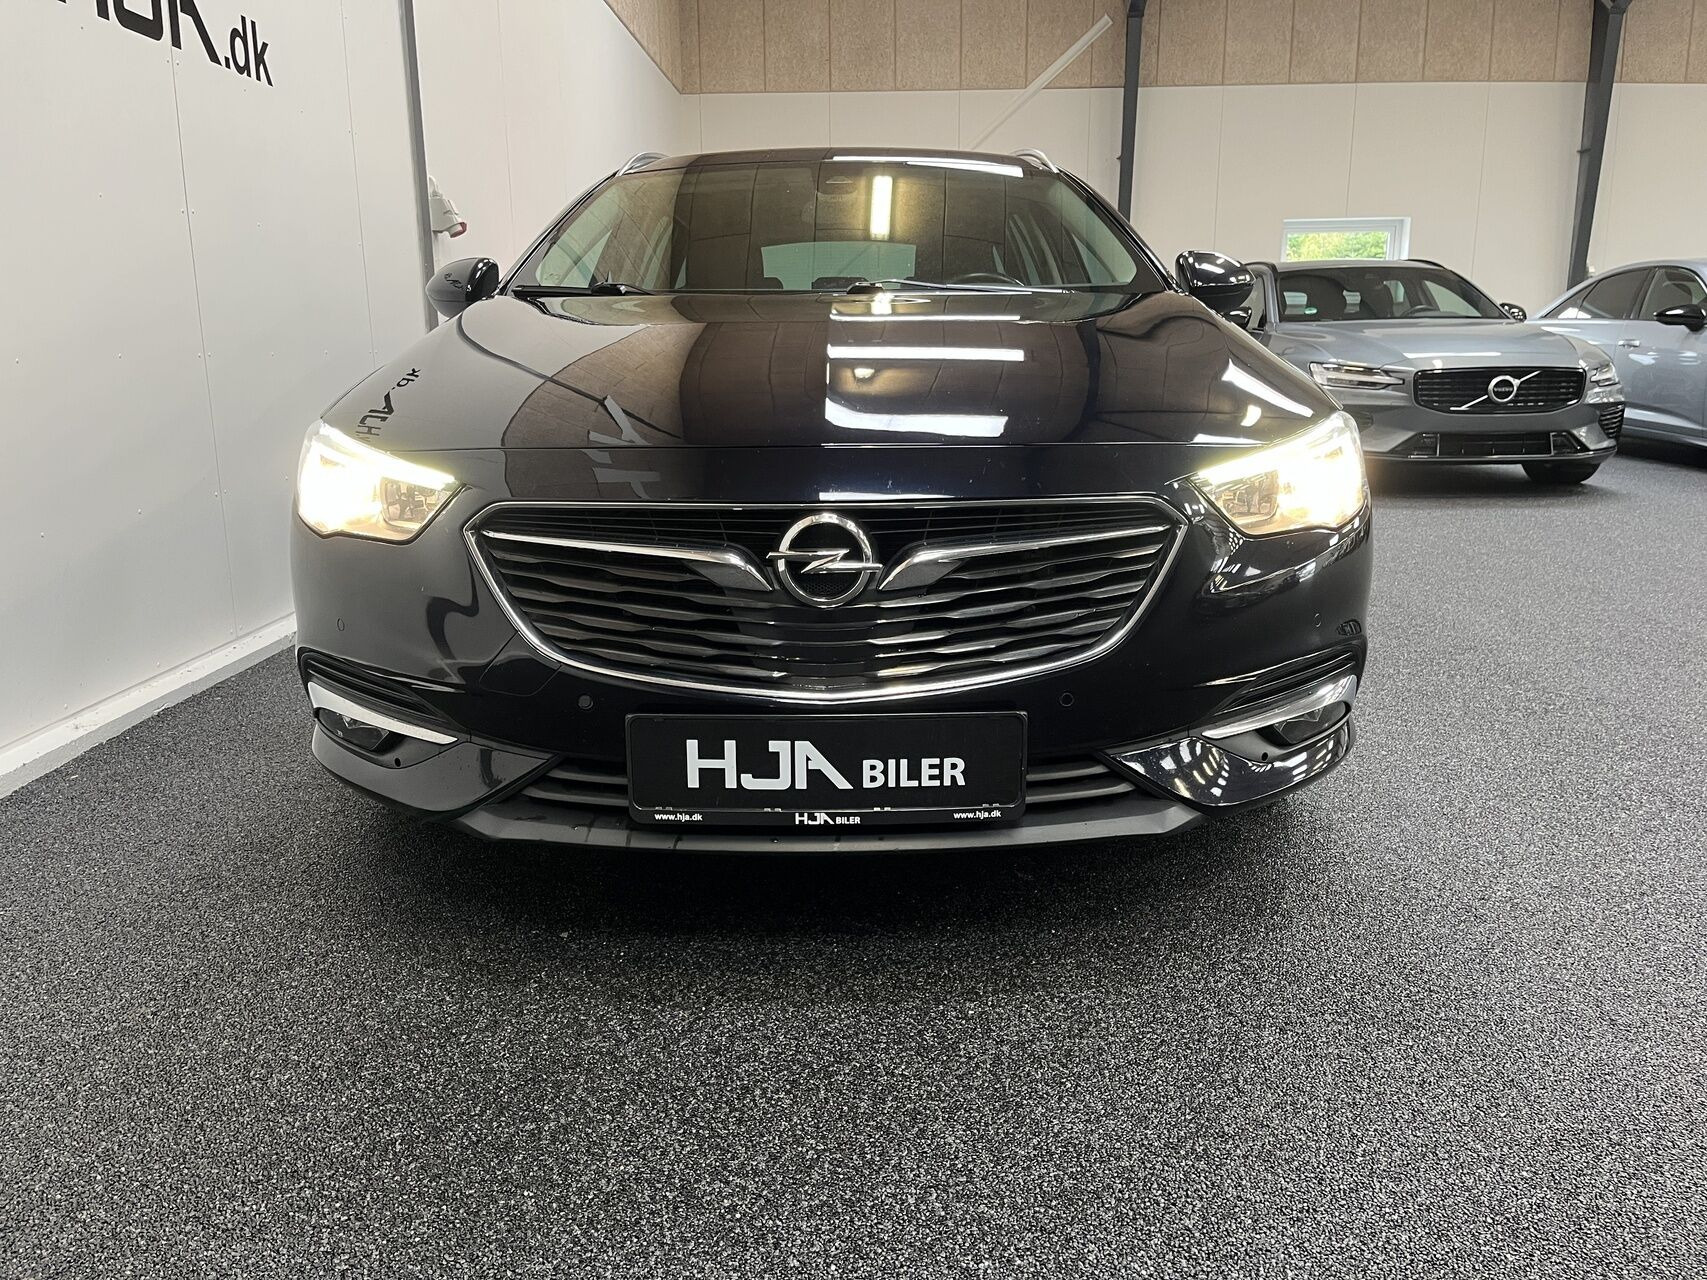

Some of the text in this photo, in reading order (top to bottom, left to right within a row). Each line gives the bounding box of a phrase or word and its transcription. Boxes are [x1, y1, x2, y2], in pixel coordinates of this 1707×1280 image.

[57, 0, 274, 87] A.dk
[686, 739, 966, 790] HJA BILER
[654, 812, 703, 823] www.hja.dk
[795, 812, 861, 825] HJA BILER
[953, 809, 1002, 820] www.hja.dk
